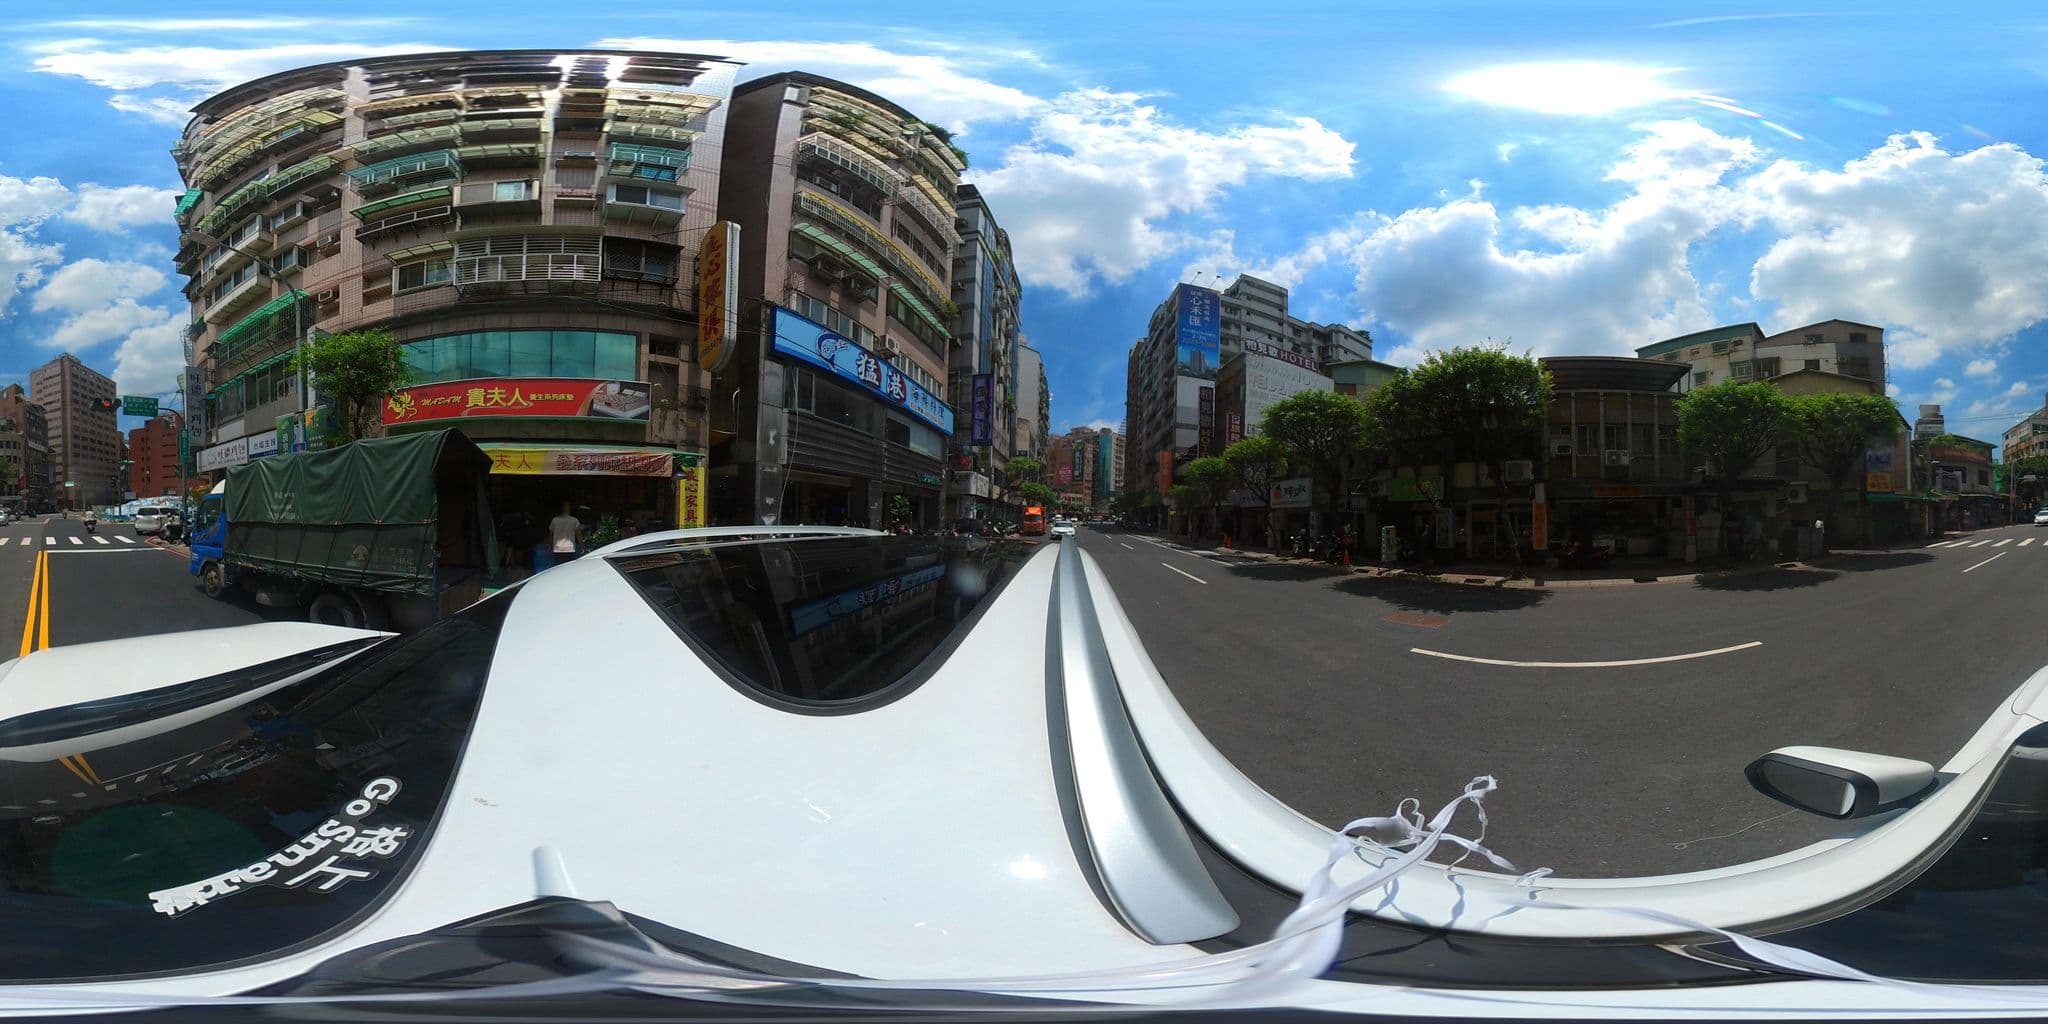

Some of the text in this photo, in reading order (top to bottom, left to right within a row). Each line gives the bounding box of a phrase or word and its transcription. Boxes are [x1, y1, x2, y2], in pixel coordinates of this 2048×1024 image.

[856, 353, 906, 400] 猛港
[1280, 350, 1318, 372] HOTEL
[420, 393, 463, 408] MADAM
[465, 386, 528, 408] 貴夫人
[494, 453, 533, 470] 夫人
[345, 777, 399, 817] Go
[285, 826, 408, 893] 格上
